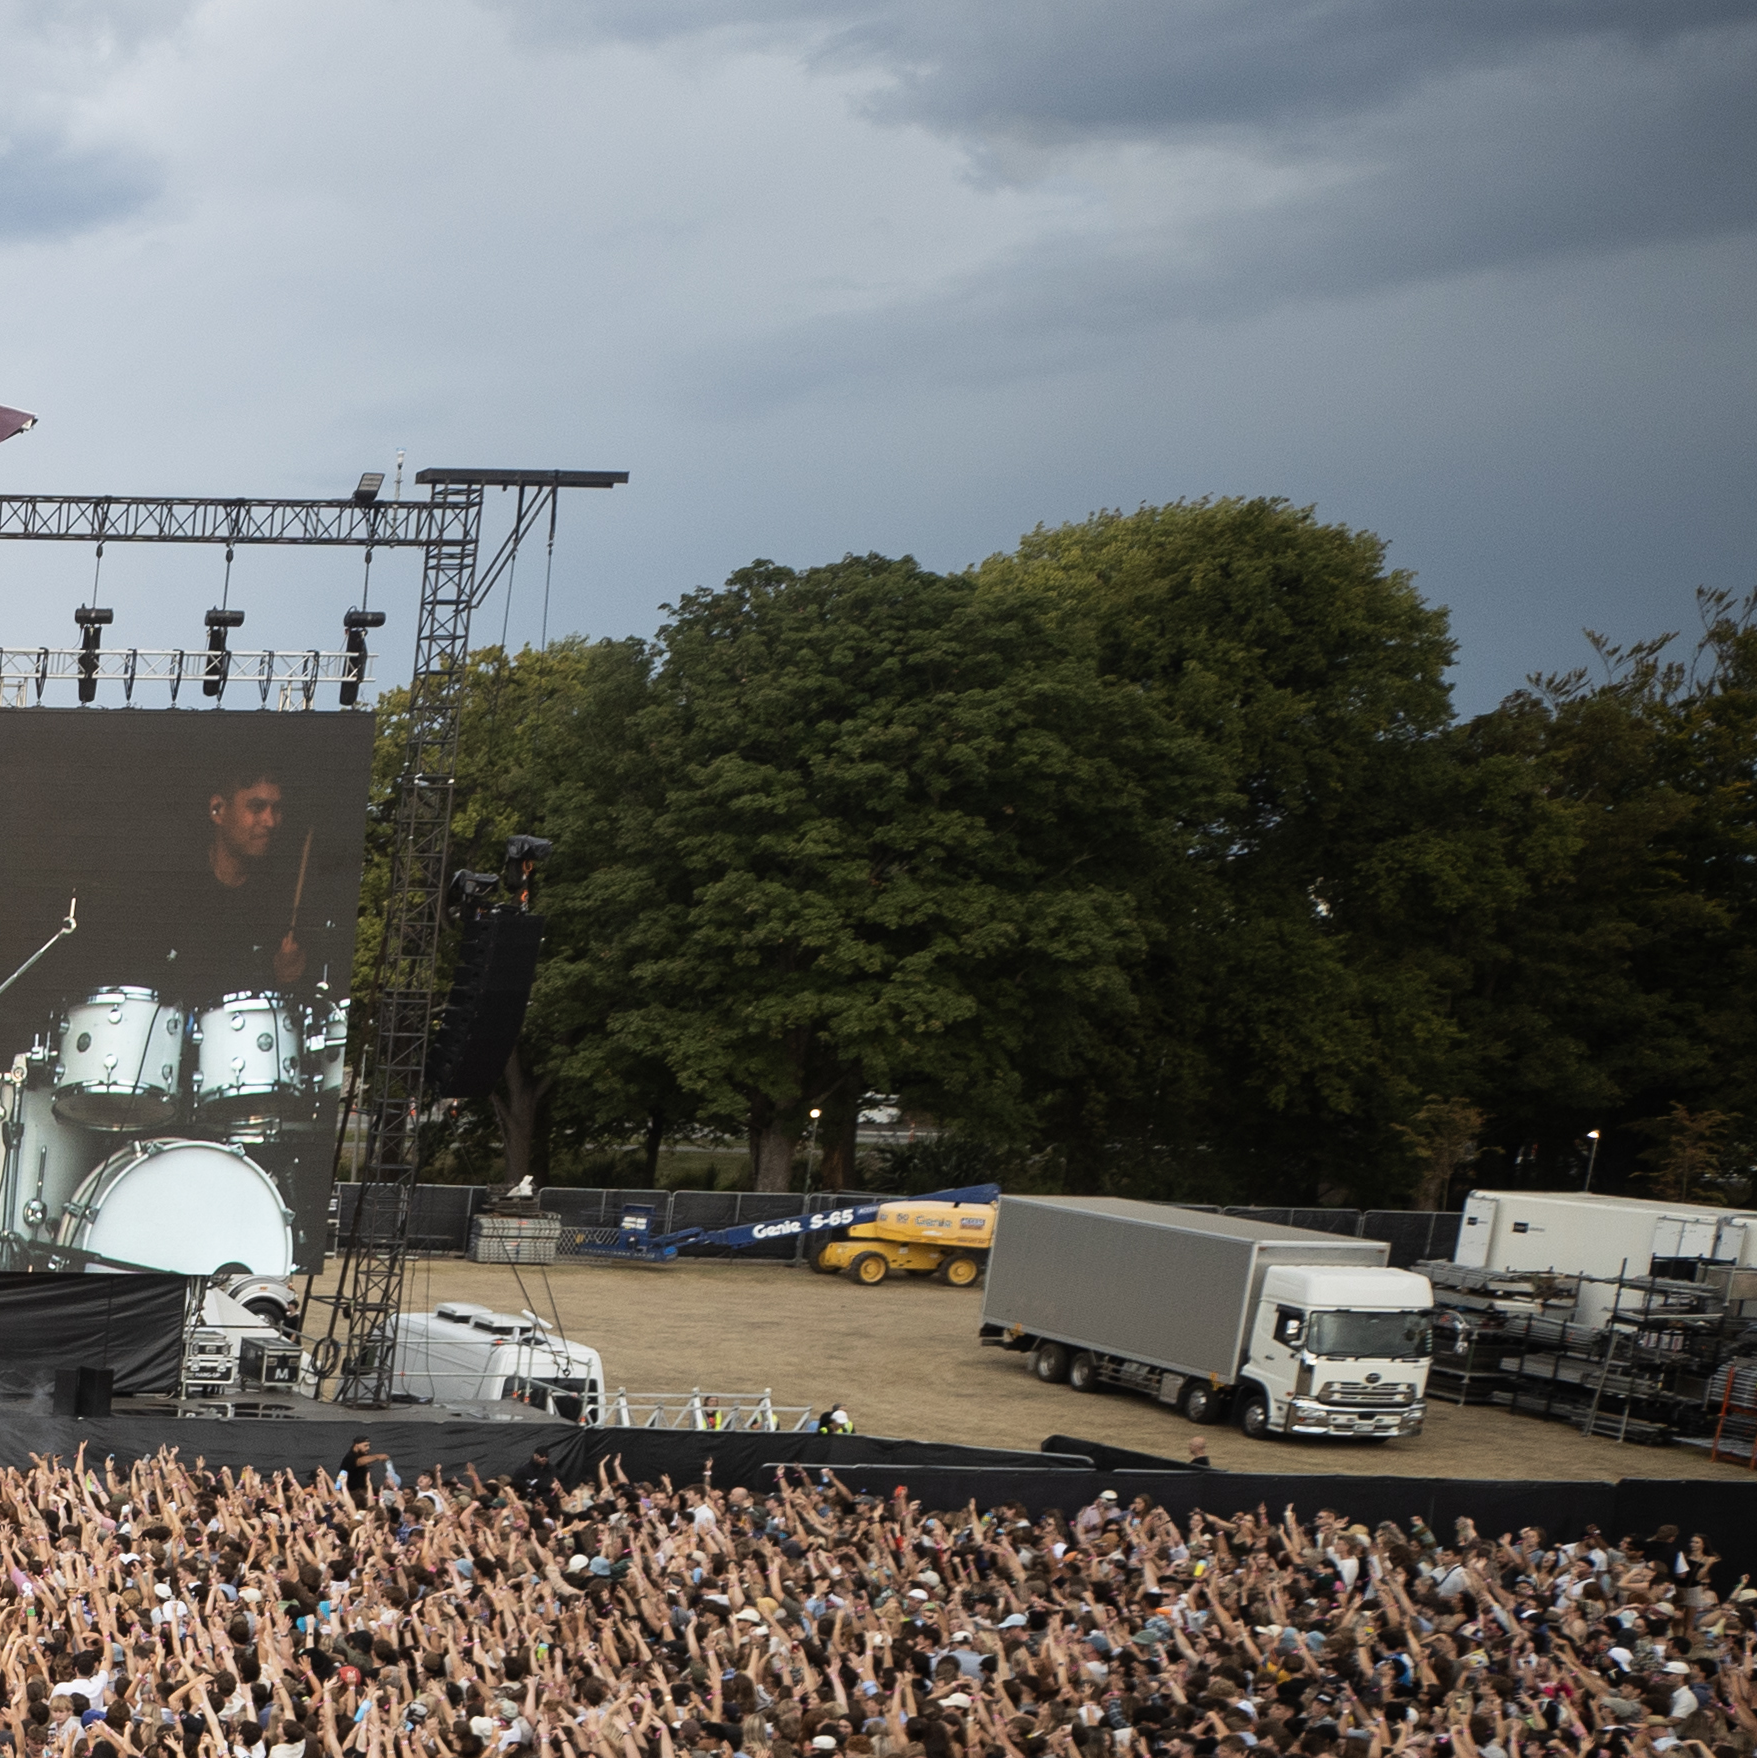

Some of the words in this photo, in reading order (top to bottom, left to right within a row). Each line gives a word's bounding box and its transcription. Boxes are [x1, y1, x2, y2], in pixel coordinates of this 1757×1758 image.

[752, 1219, 803, 1239] Genie
[810, 1209, 853, 1230] S-65
[274, 1367, 289, 1379] M
